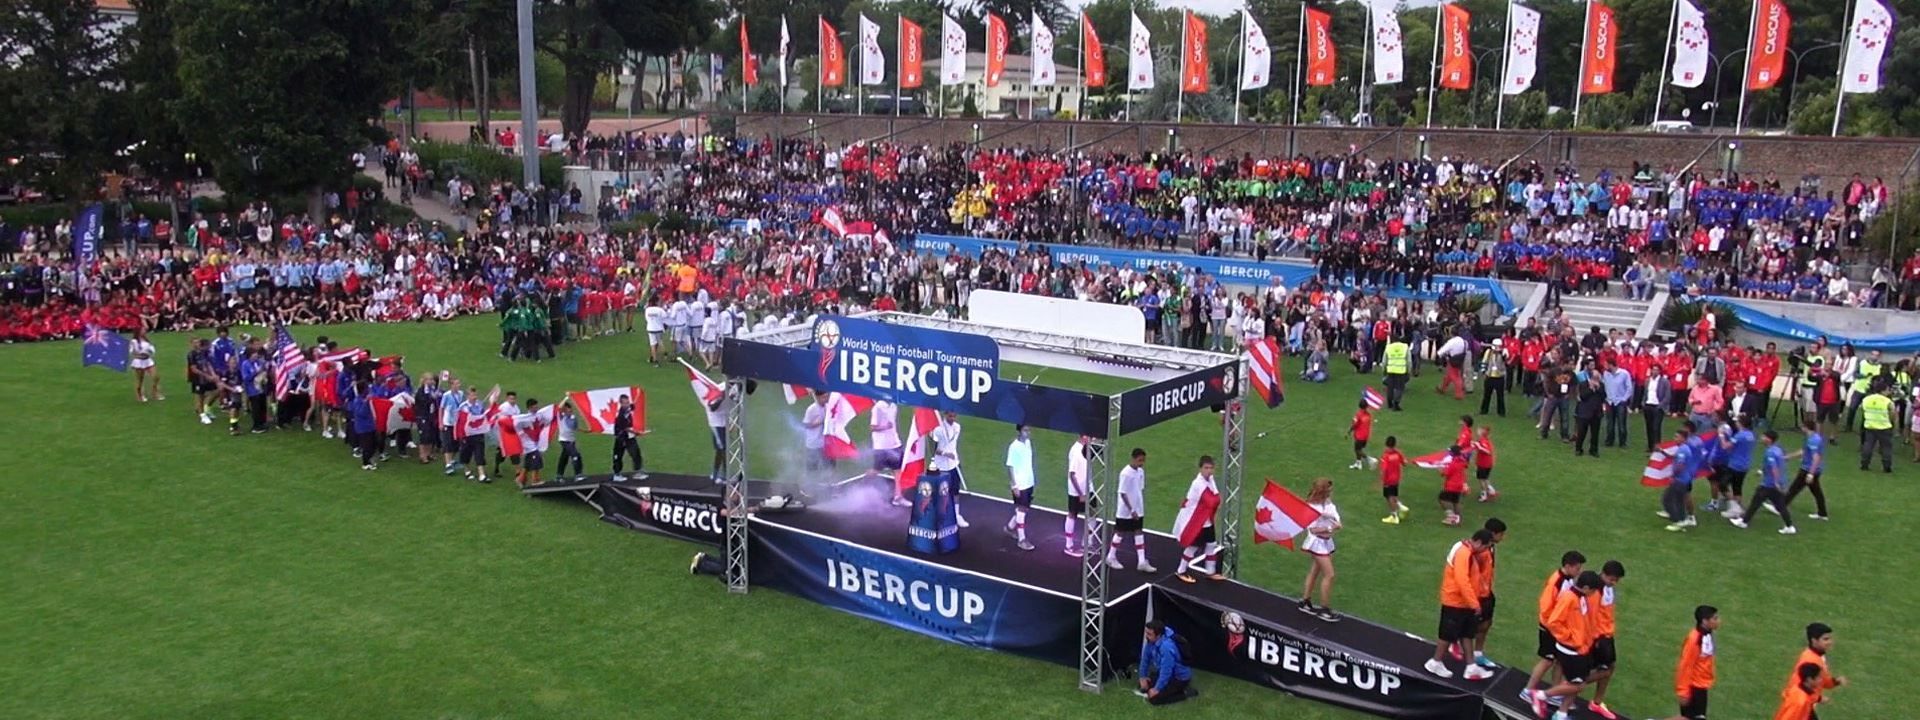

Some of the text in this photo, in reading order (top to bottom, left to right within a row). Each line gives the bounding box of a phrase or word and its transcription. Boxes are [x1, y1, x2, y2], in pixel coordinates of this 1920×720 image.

[1596, 11, 1609, 60] CASCAIS
[1764, 4, 1780, 55] CASCAIS
[840, 350, 992, 403] IBERCUP
[842, 337, 993, 369] World Youth Football Tournament
[1150, 381, 1205, 415] IBERCUP
[652, 501, 722, 534] IBERCU
[826, 558, 985, 624] IBERCUP
[1248, 636, 1401, 695] IBERCUP
[1249, 627, 1401, 674] World Youth Football Tournament
